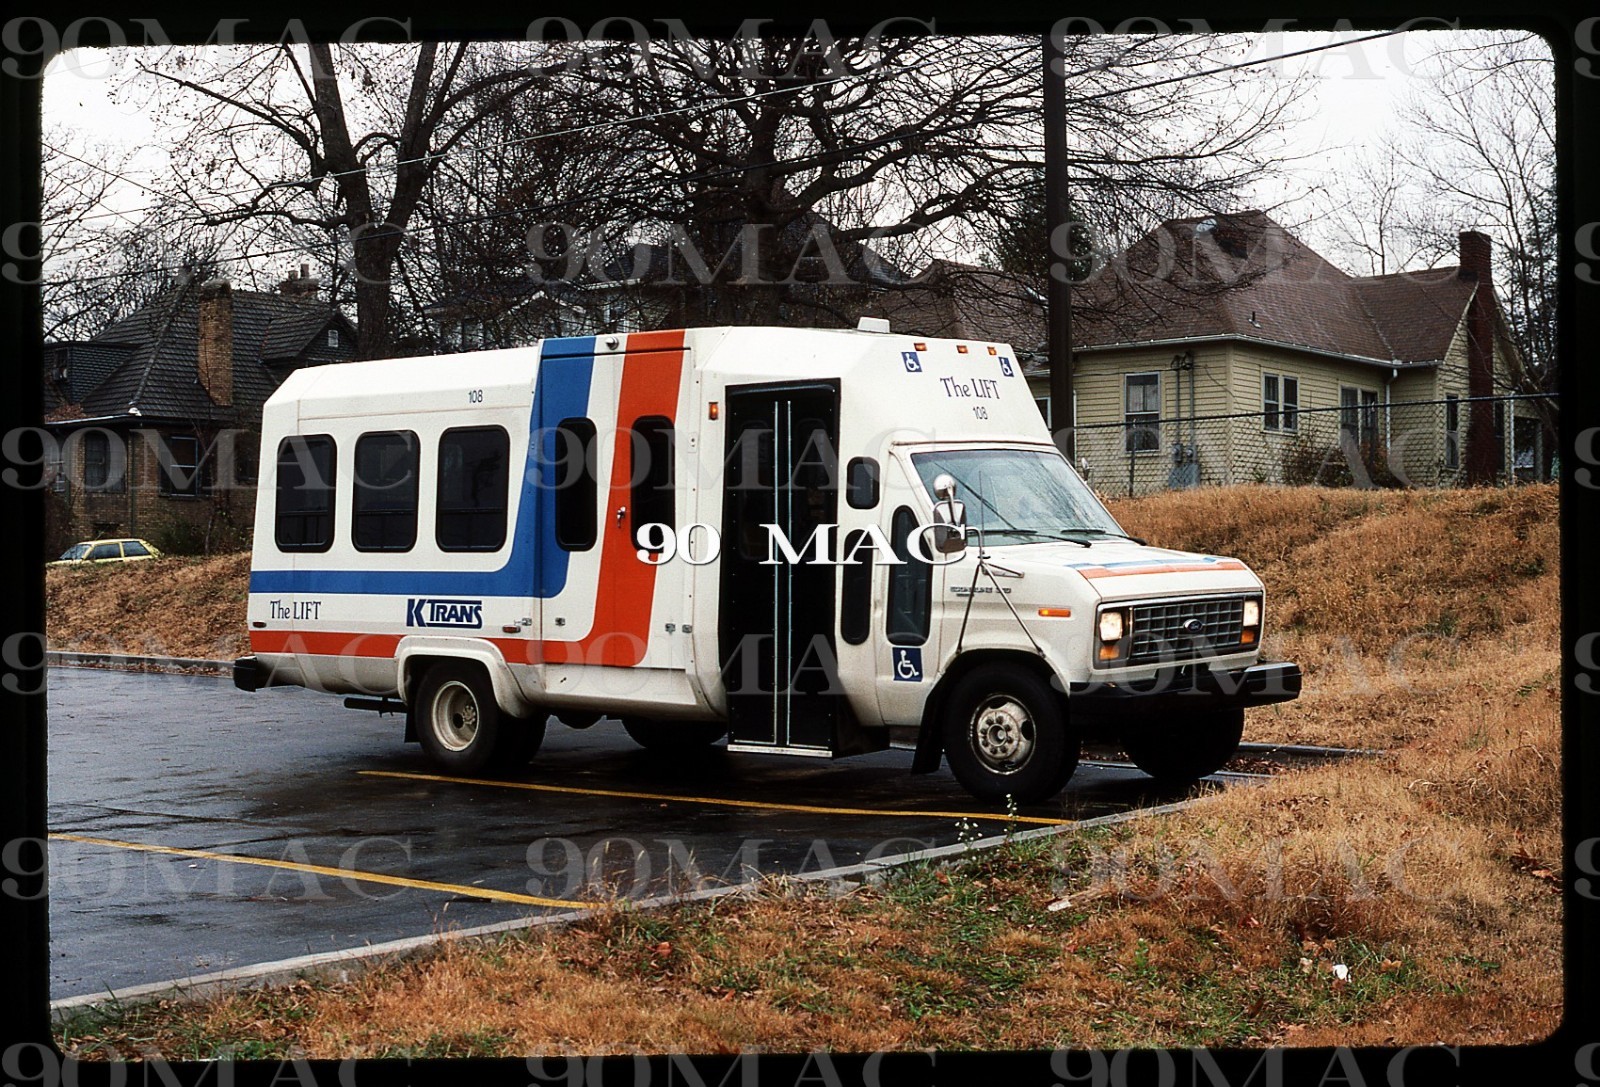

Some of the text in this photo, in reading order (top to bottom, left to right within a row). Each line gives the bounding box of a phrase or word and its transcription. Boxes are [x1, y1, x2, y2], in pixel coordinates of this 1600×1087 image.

[940, 376, 1000, 399] The LIFT
[468, 389, 483, 403] 108
[973, 406, 988, 420] 108
[270, 600, 321, 619] The LIFT
